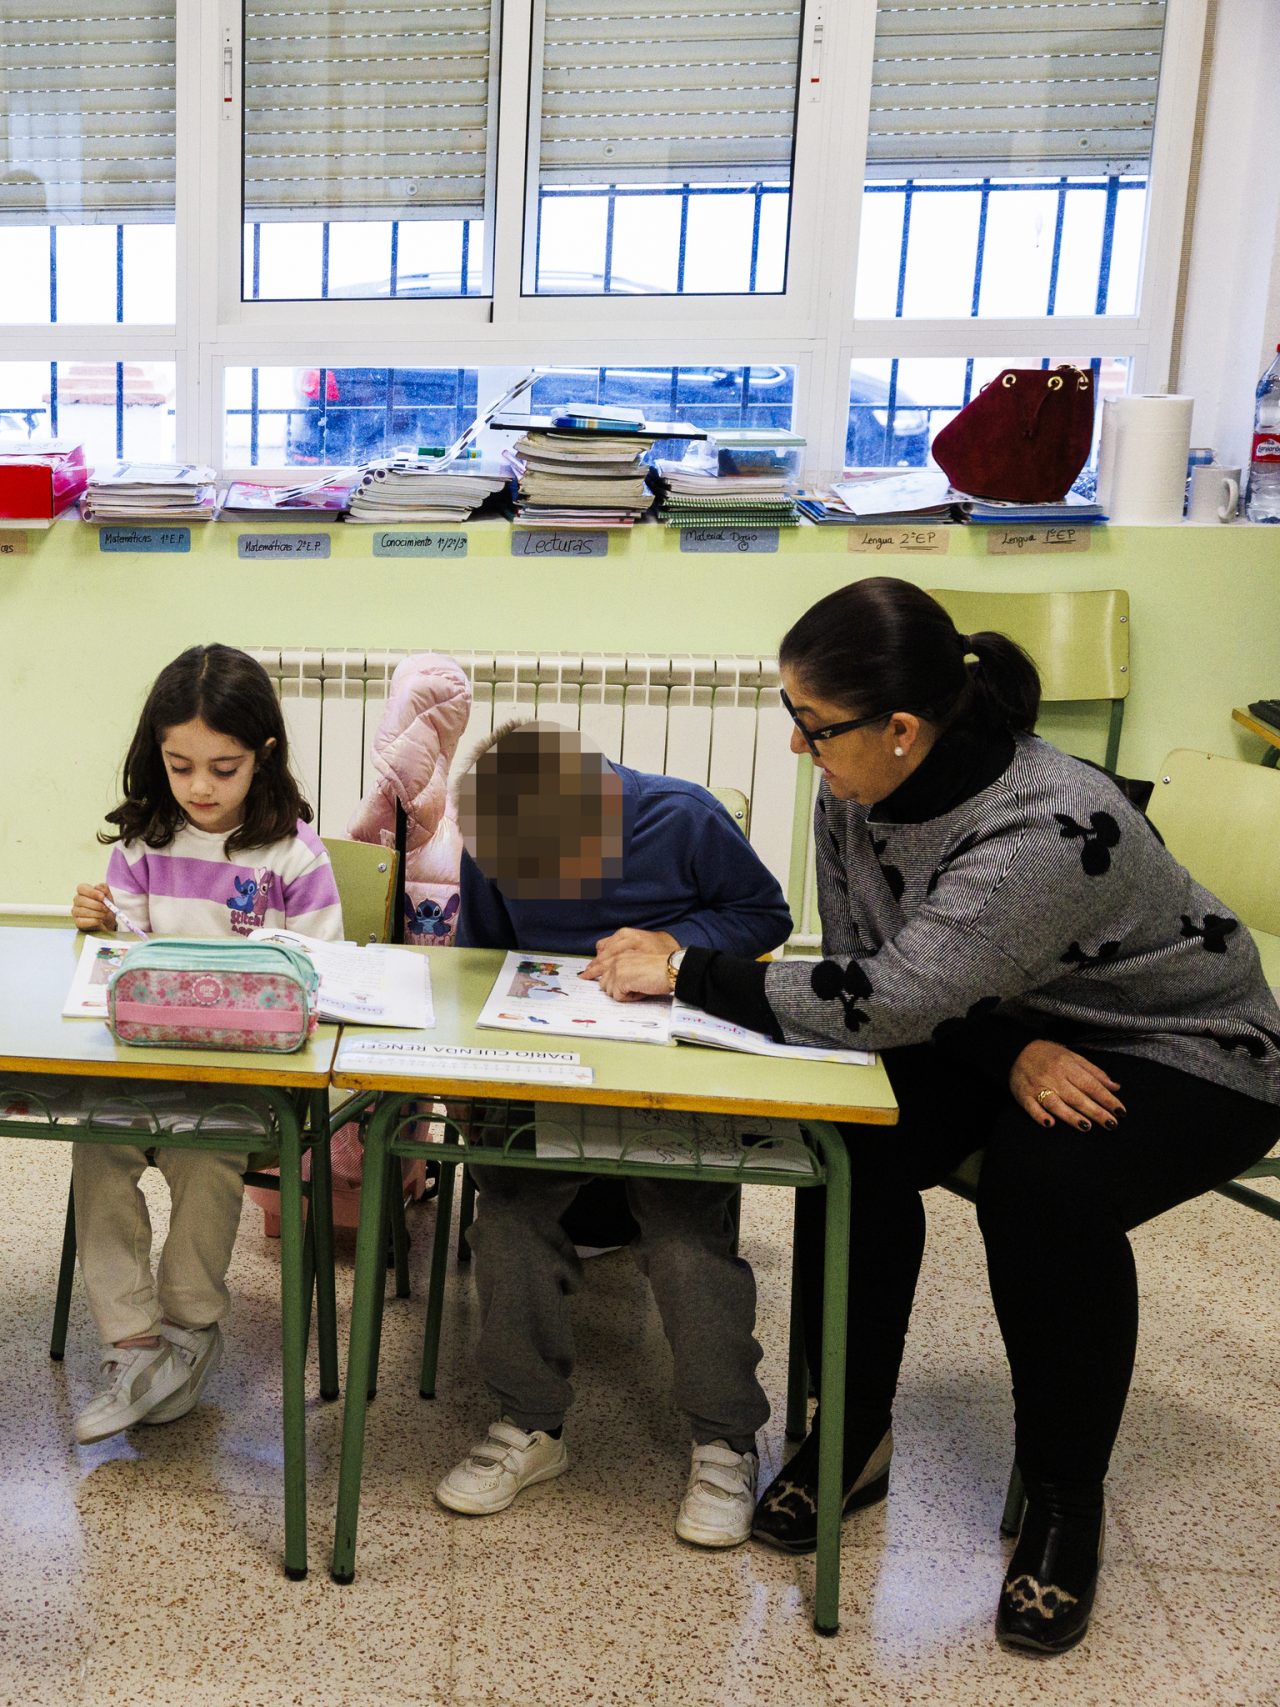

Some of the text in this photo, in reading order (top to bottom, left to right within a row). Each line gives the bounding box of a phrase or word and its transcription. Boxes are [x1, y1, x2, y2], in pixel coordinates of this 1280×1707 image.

[381, 533, 433, 549] Conocimiento
[523, 531, 594, 555] Lecturas
[861, 532, 894, 550] Lengua
[1002, 531, 1037, 548] Lengua
[433, 1046, 510, 1057] CUENDA
[515, 1051, 573, 1061] DARÍO
